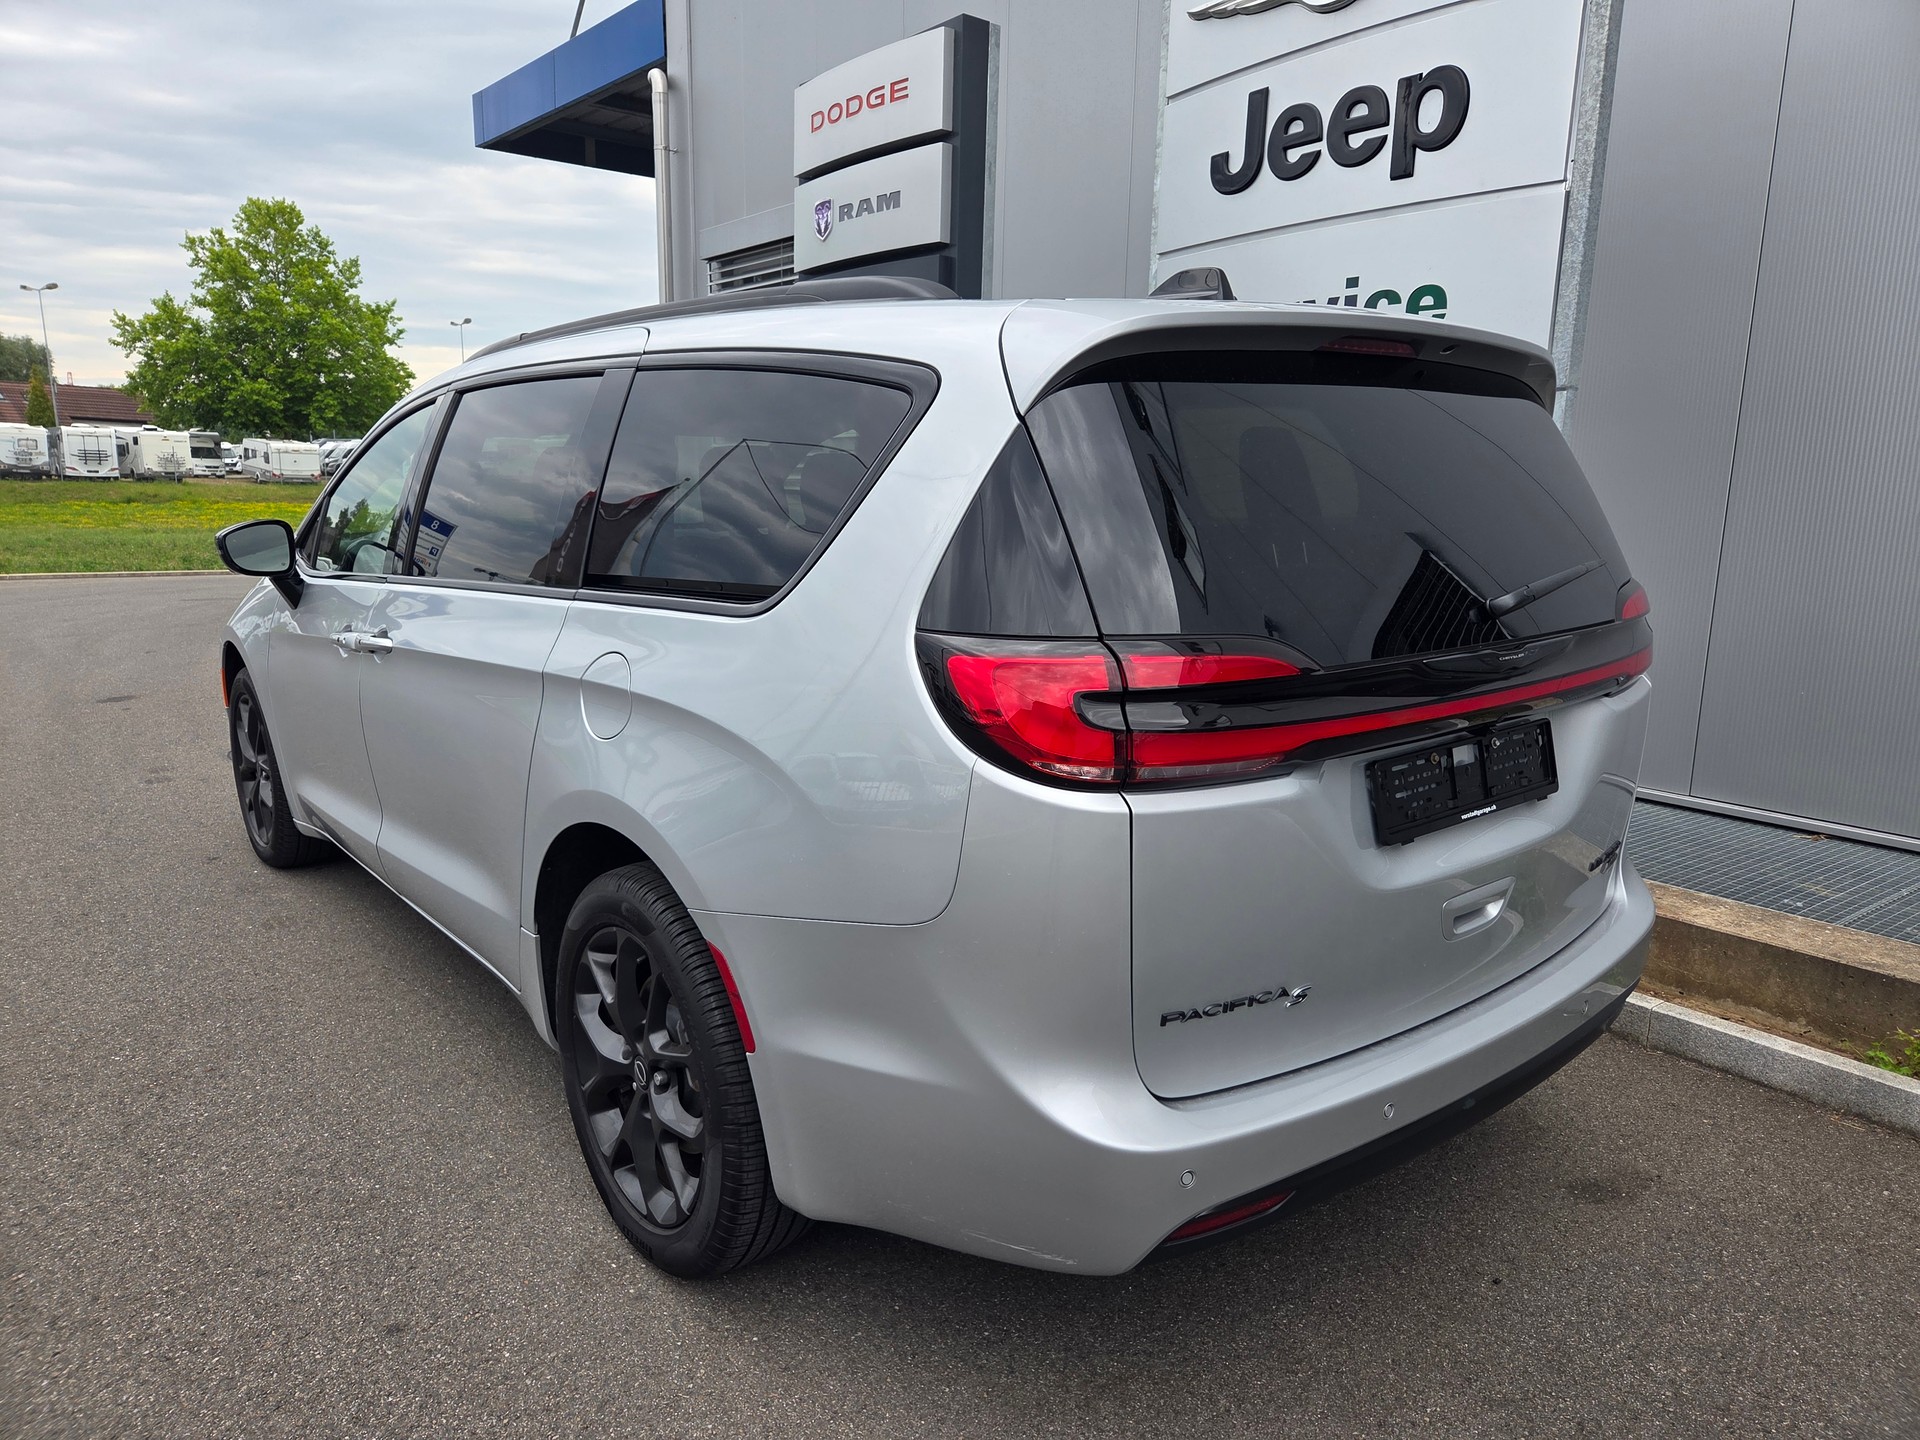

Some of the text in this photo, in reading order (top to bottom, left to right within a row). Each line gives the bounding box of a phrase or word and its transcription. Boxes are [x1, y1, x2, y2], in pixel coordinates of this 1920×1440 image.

[811, 77, 910, 134] DODGE
[1210, 64, 1471, 196] Jeep
[838, 190, 901, 223] RAM
[1160, 986, 1291, 1027] PACIFICA
